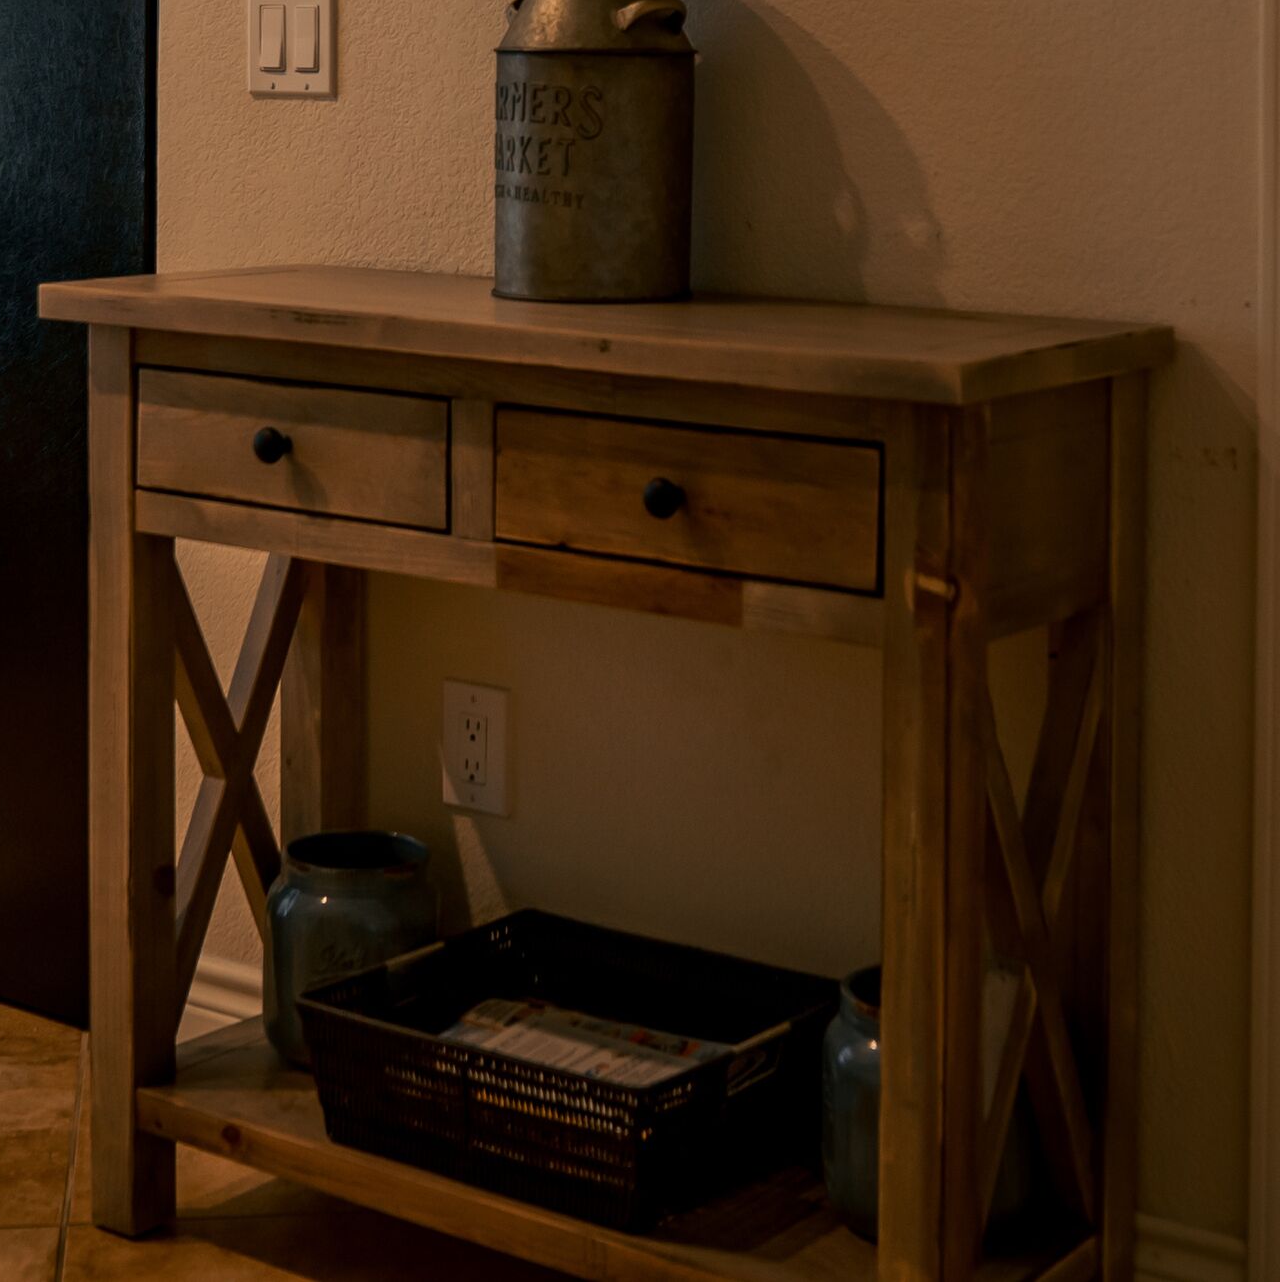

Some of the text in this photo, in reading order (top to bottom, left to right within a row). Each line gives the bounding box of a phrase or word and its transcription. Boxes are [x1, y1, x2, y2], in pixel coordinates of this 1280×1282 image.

[496, 81, 605, 141] RMERS
[496, 133, 577, 177] ARKET
[514, 184, 585, 210] HEALTHY
